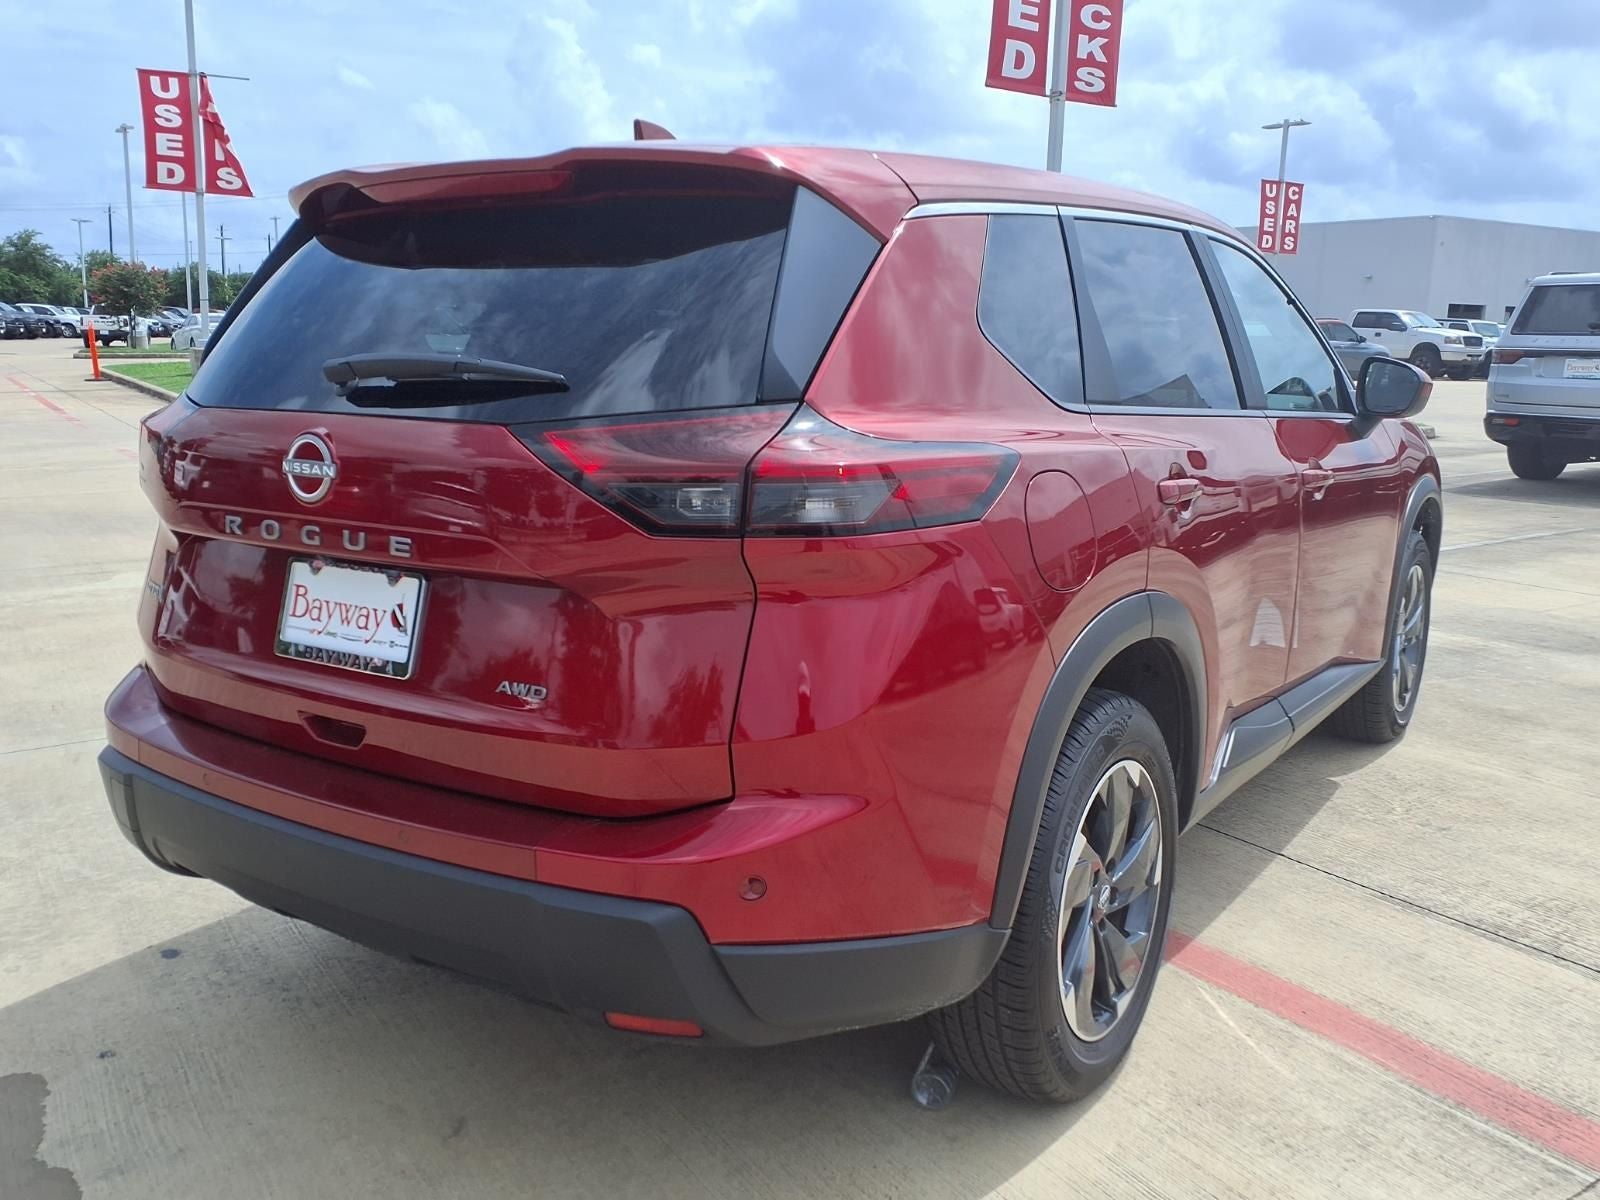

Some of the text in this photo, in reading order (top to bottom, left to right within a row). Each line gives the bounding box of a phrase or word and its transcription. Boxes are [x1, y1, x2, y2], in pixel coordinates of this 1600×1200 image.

[1074, 4, 1112, 93] CKS
[149, 75, 185, 185] USED
[1261, 183, 1277, 249] USED
[1283, 186, 1300, 250] CARS
[282, 461, 335, 477] NISSAN
[224, 515, 413, 558] ROGUE
[289, 584, 388, 644] Bayway
[303, 645, 376, 671] BAYWAY
[495, 680, 547, 699] AWD
